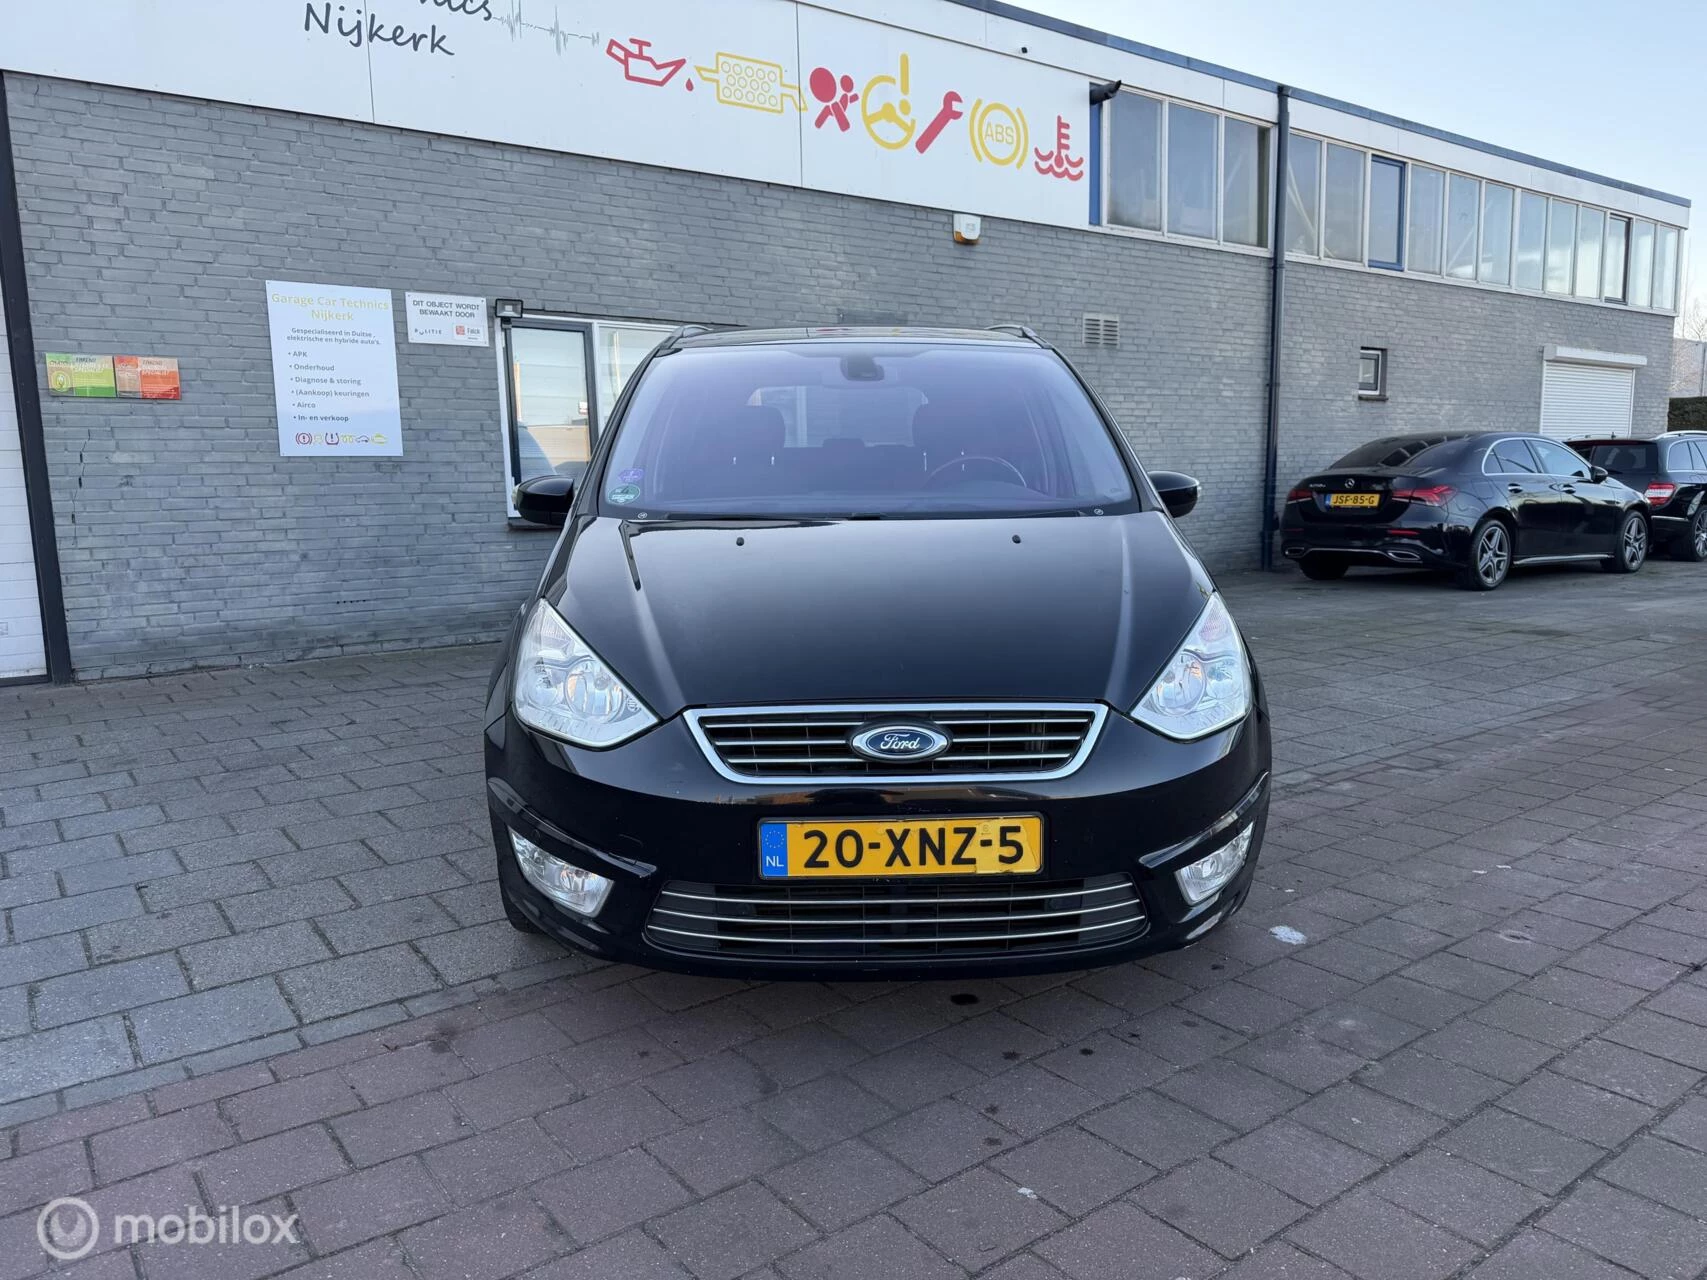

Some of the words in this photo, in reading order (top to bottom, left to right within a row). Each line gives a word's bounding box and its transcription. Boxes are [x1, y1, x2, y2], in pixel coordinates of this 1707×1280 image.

[304, 2, 455, 56] Nijkerk
[984, 122, 1014, 145] ABS
[271, 293, 315, 308] Garage
[317, 296, 337, 307] Car
[340, 297, 390, 310] Technics
[426, 301, 454, 309] OBJECT
[455, 303, 480, 311] WORDT
[311, 309, 354, 321] Nijkerk
[419, 309, 453, 317] BEWAAKT
[455, 311, 475, 319] DOOR
[291, 327, 342, 337] Gespecialiseerd
[286, 335, 323, 343] elektrische
[334, 337, 359, 345] hybride
[292, 350, 308, 358] APK
[293, 363, 335, 371] Onderhoud
[295, 376, 328, 385] Diagnose
[336, 377, 362, 386] storing
[296, 389, 333, 397] (Aankoop)
[334, 390, 370, 399] keuringen
[320, 415, 349, 423] verkoop
[1333, 495, 1375, 505] JSF-85-G
[880, 733, 920, 749] Ford
[803, 825, 1024, 869] 20-XNZ-5
[766, 855, 785, 868] NL
